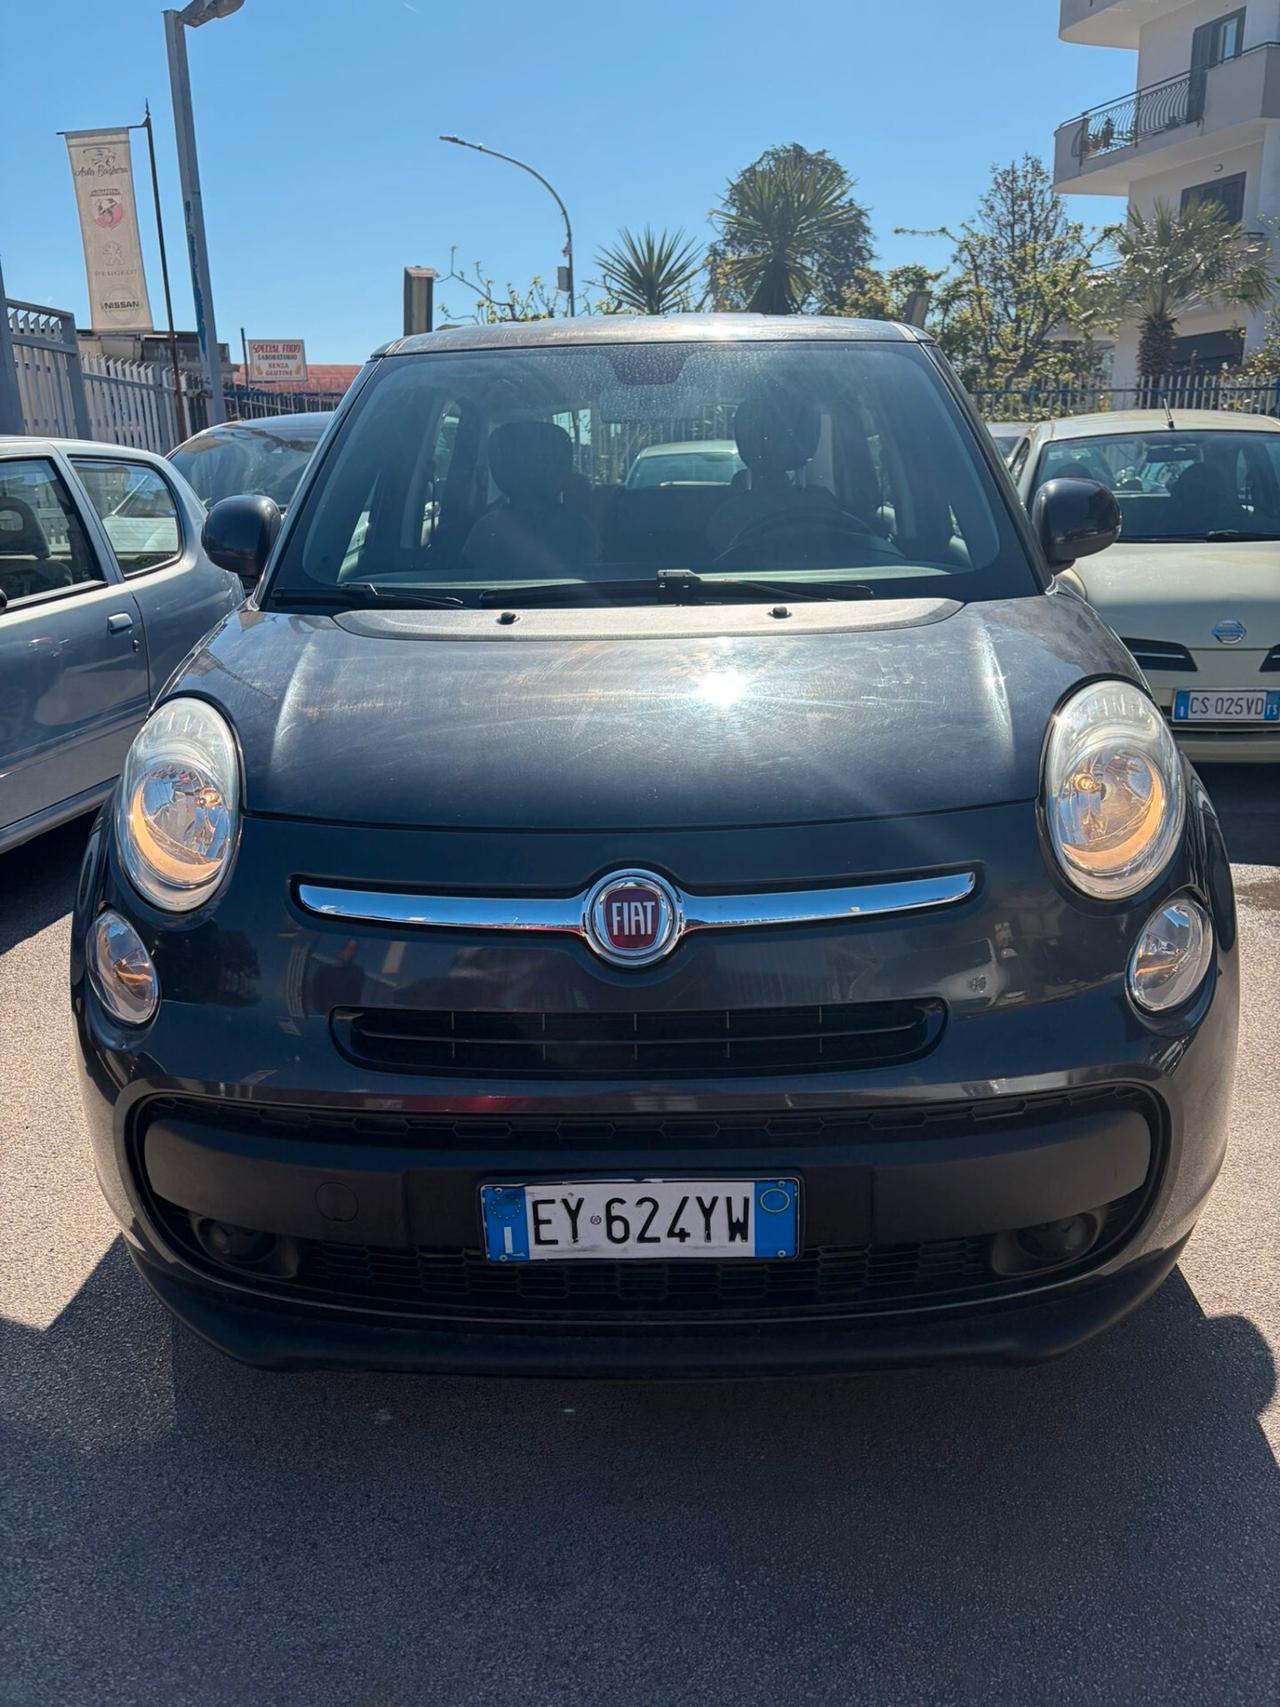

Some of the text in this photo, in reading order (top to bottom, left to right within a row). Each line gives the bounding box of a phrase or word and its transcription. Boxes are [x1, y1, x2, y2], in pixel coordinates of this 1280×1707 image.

[104, 301, 139, 309] NISSAN
[1190, 697, 1210, 715] CS
[611, 901, 656, 936] FIAT
[531, 1197, 584, 1246] EY
[605, 1195, 750, 1245] 624YW
